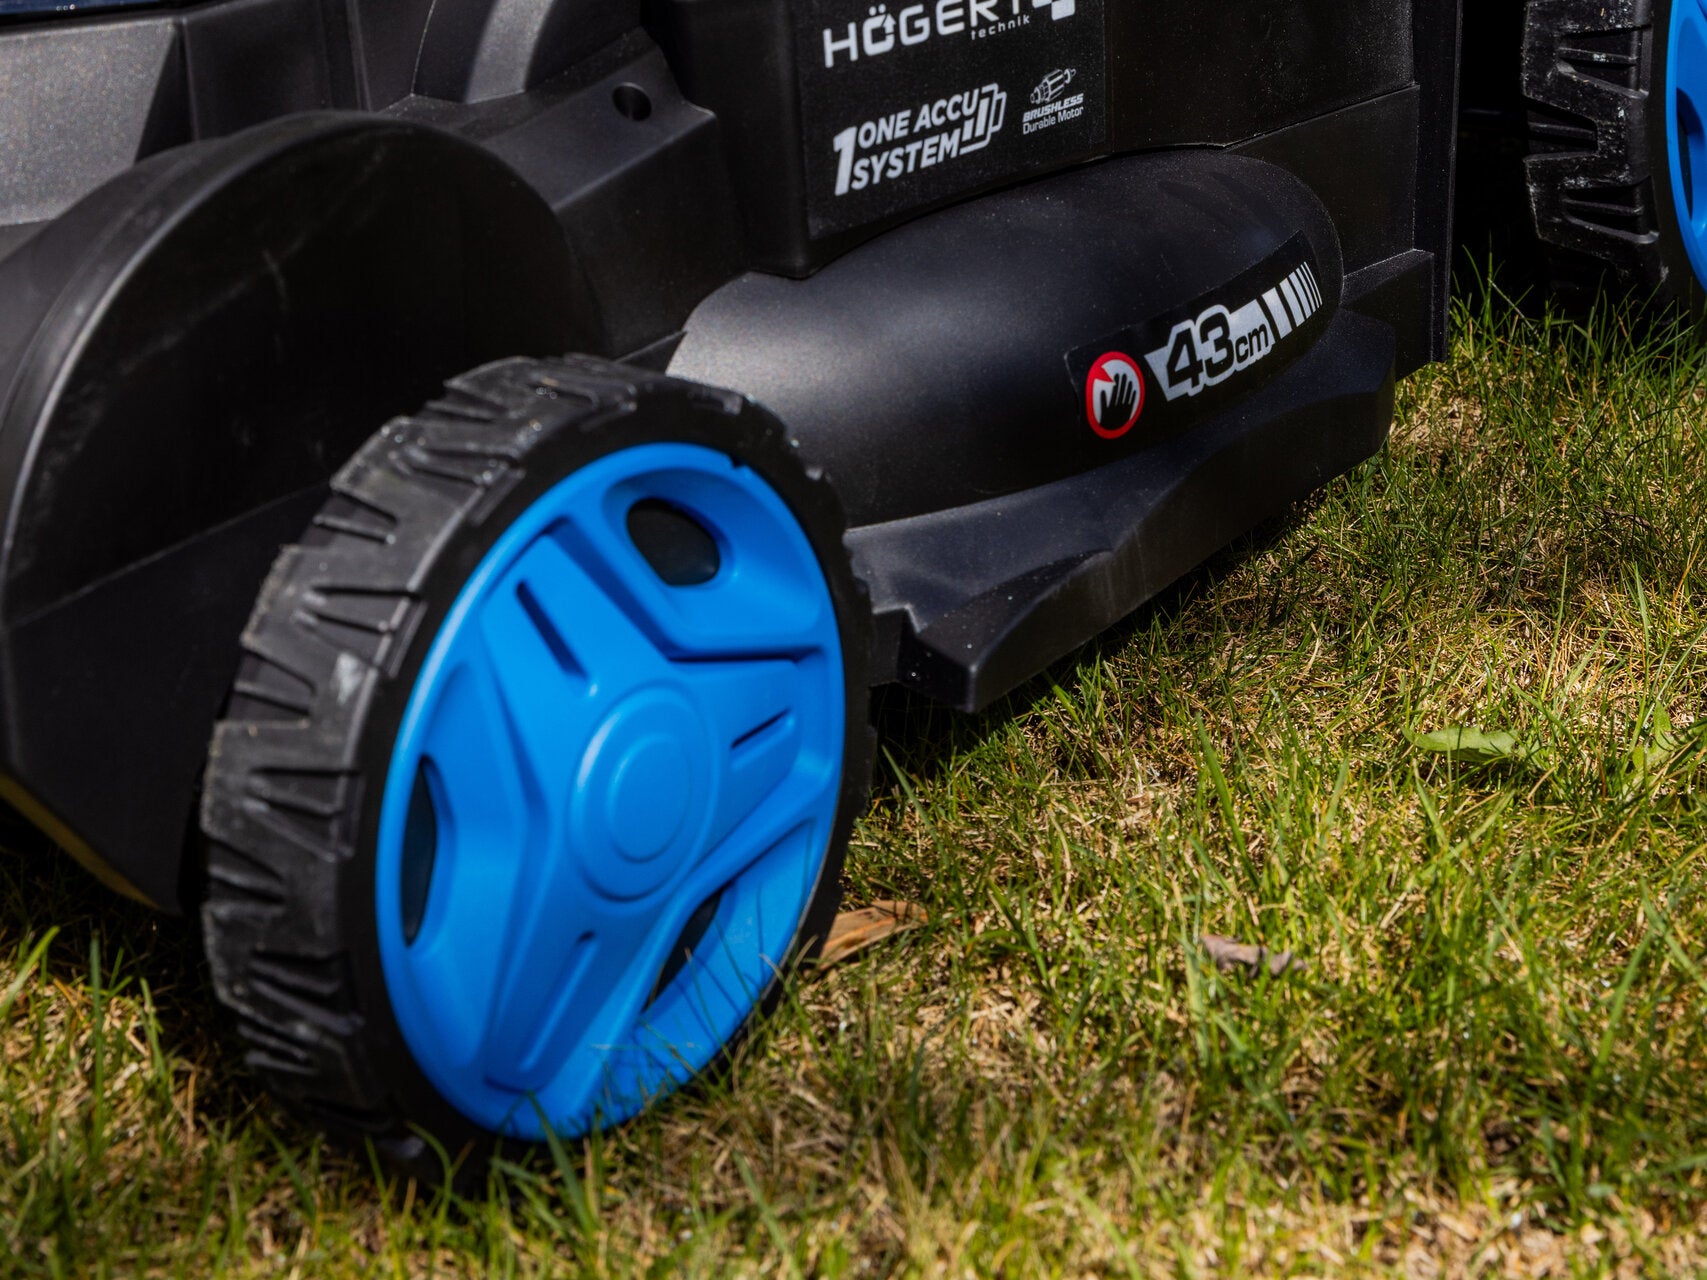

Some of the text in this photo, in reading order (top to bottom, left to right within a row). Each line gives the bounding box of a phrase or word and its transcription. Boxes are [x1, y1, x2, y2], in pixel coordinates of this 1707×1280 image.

[970, 13, 1031, 41] technik
[857, 110, 912, 149] ONE
[913, 88, 979, 133] ACCU
[1022, 92, 1085, 123] BRUSHLESS
[1022, 106, 1084, 135] Durable Motor
[851, 128, 962, 191] SYSTEM
